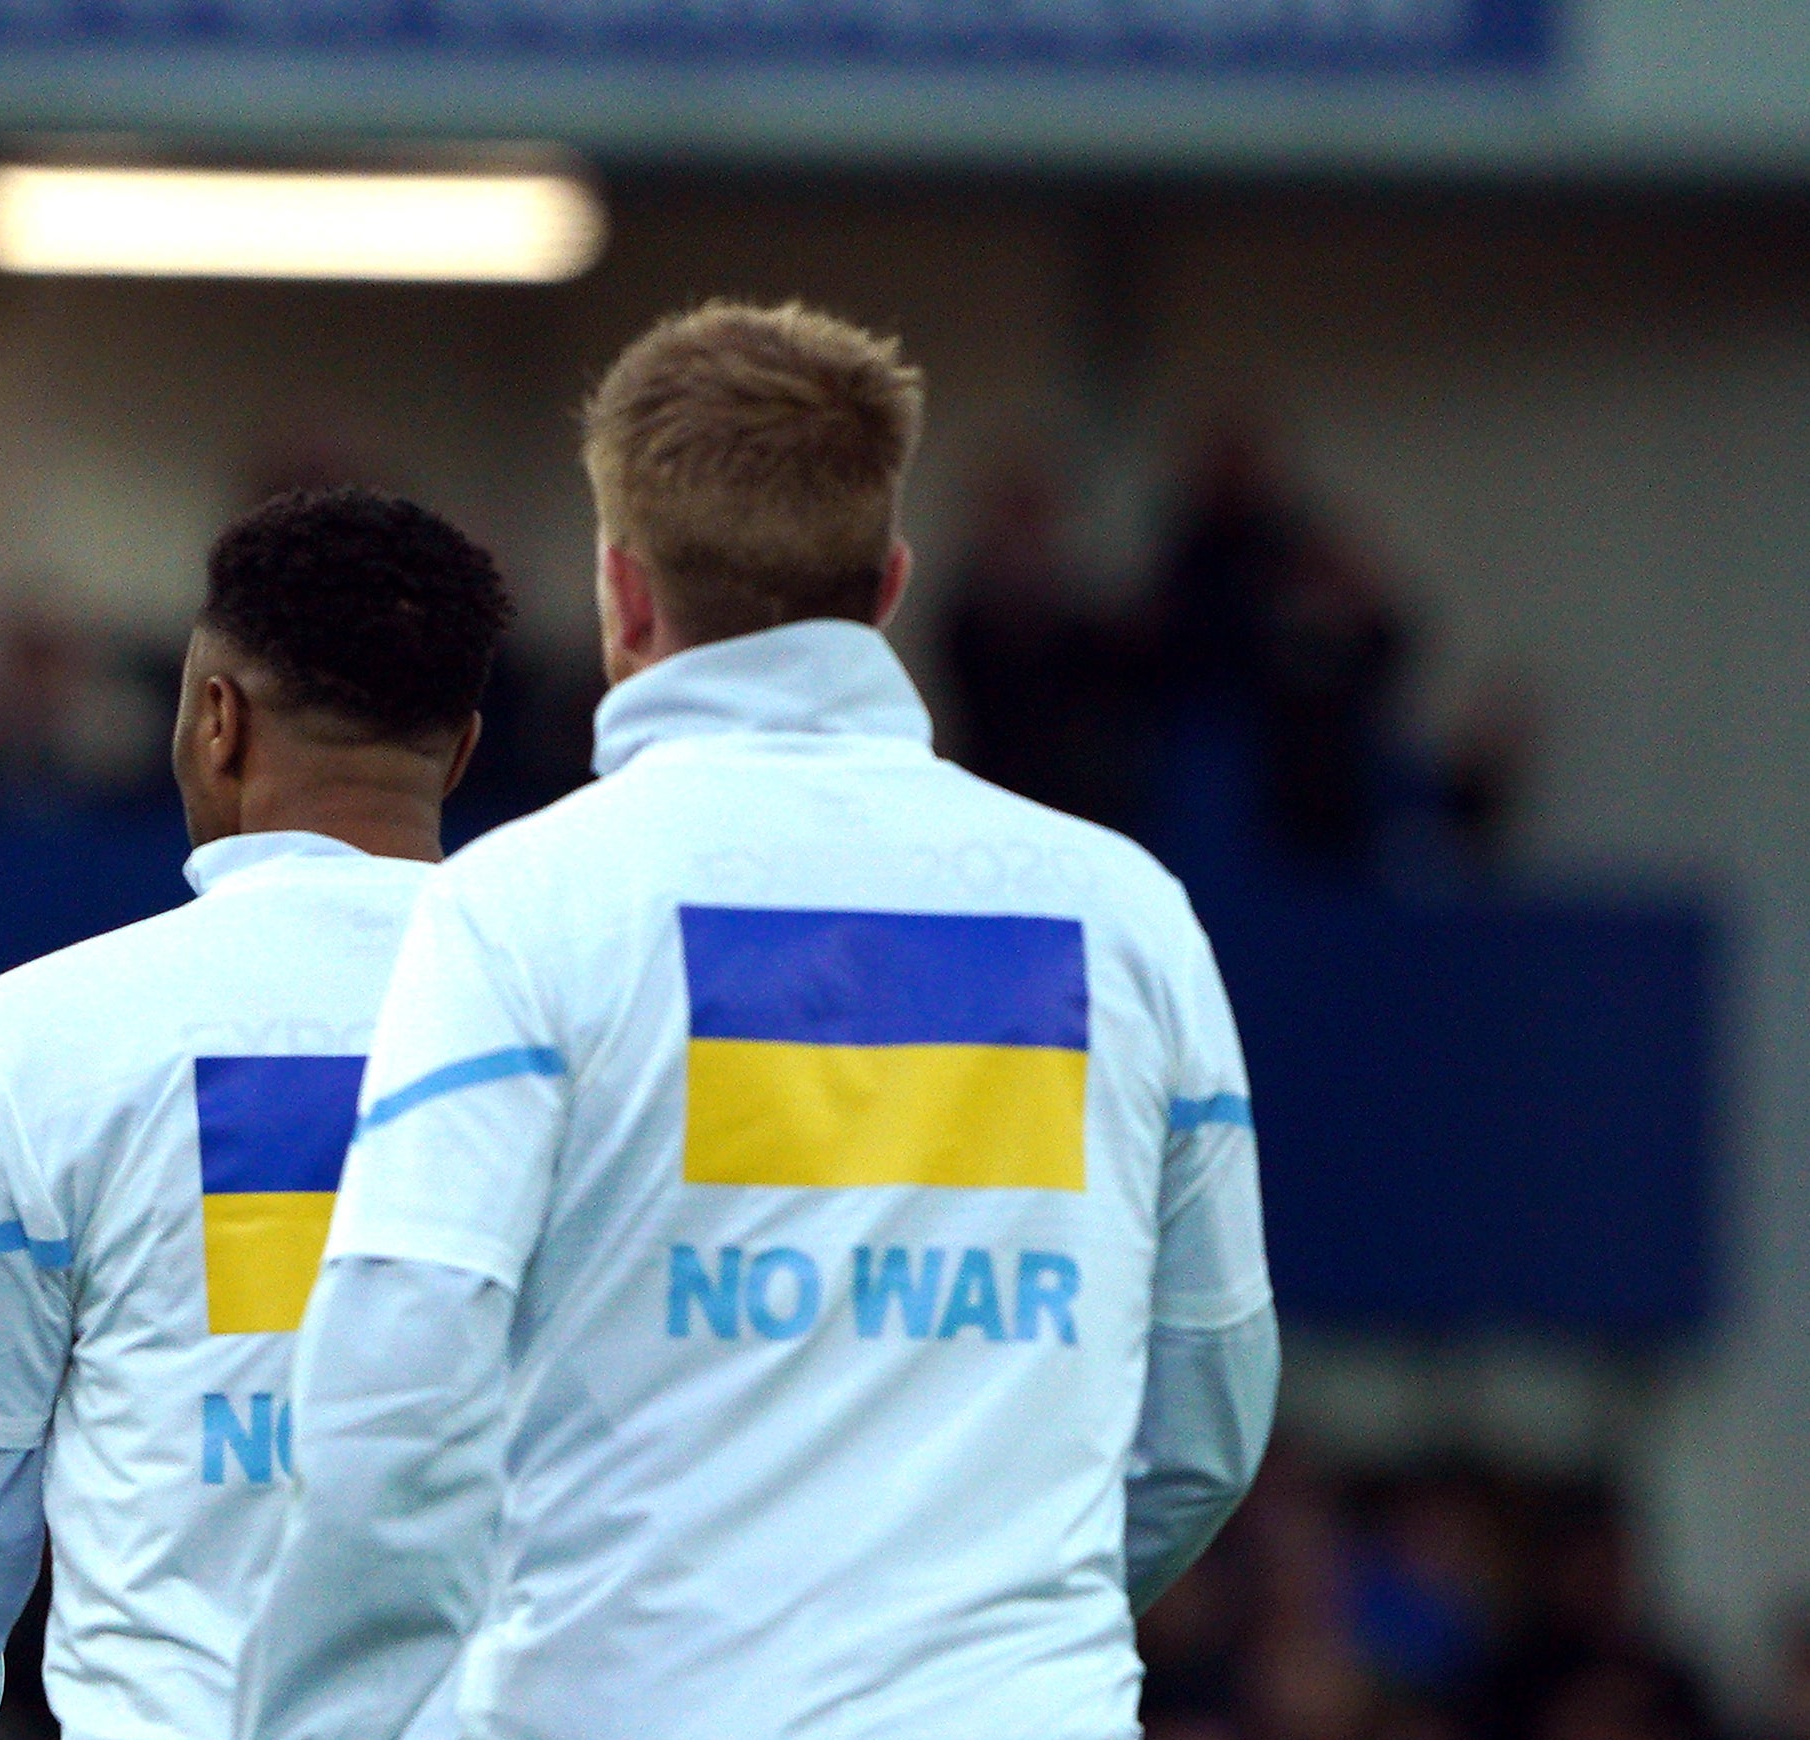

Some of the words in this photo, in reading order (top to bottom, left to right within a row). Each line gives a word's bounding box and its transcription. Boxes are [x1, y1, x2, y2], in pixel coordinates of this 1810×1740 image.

[665, 1242, 824, 1342] NO
[852, 1244, 1083, 1346] WAR
[201, 1391, 293, 1486] N
